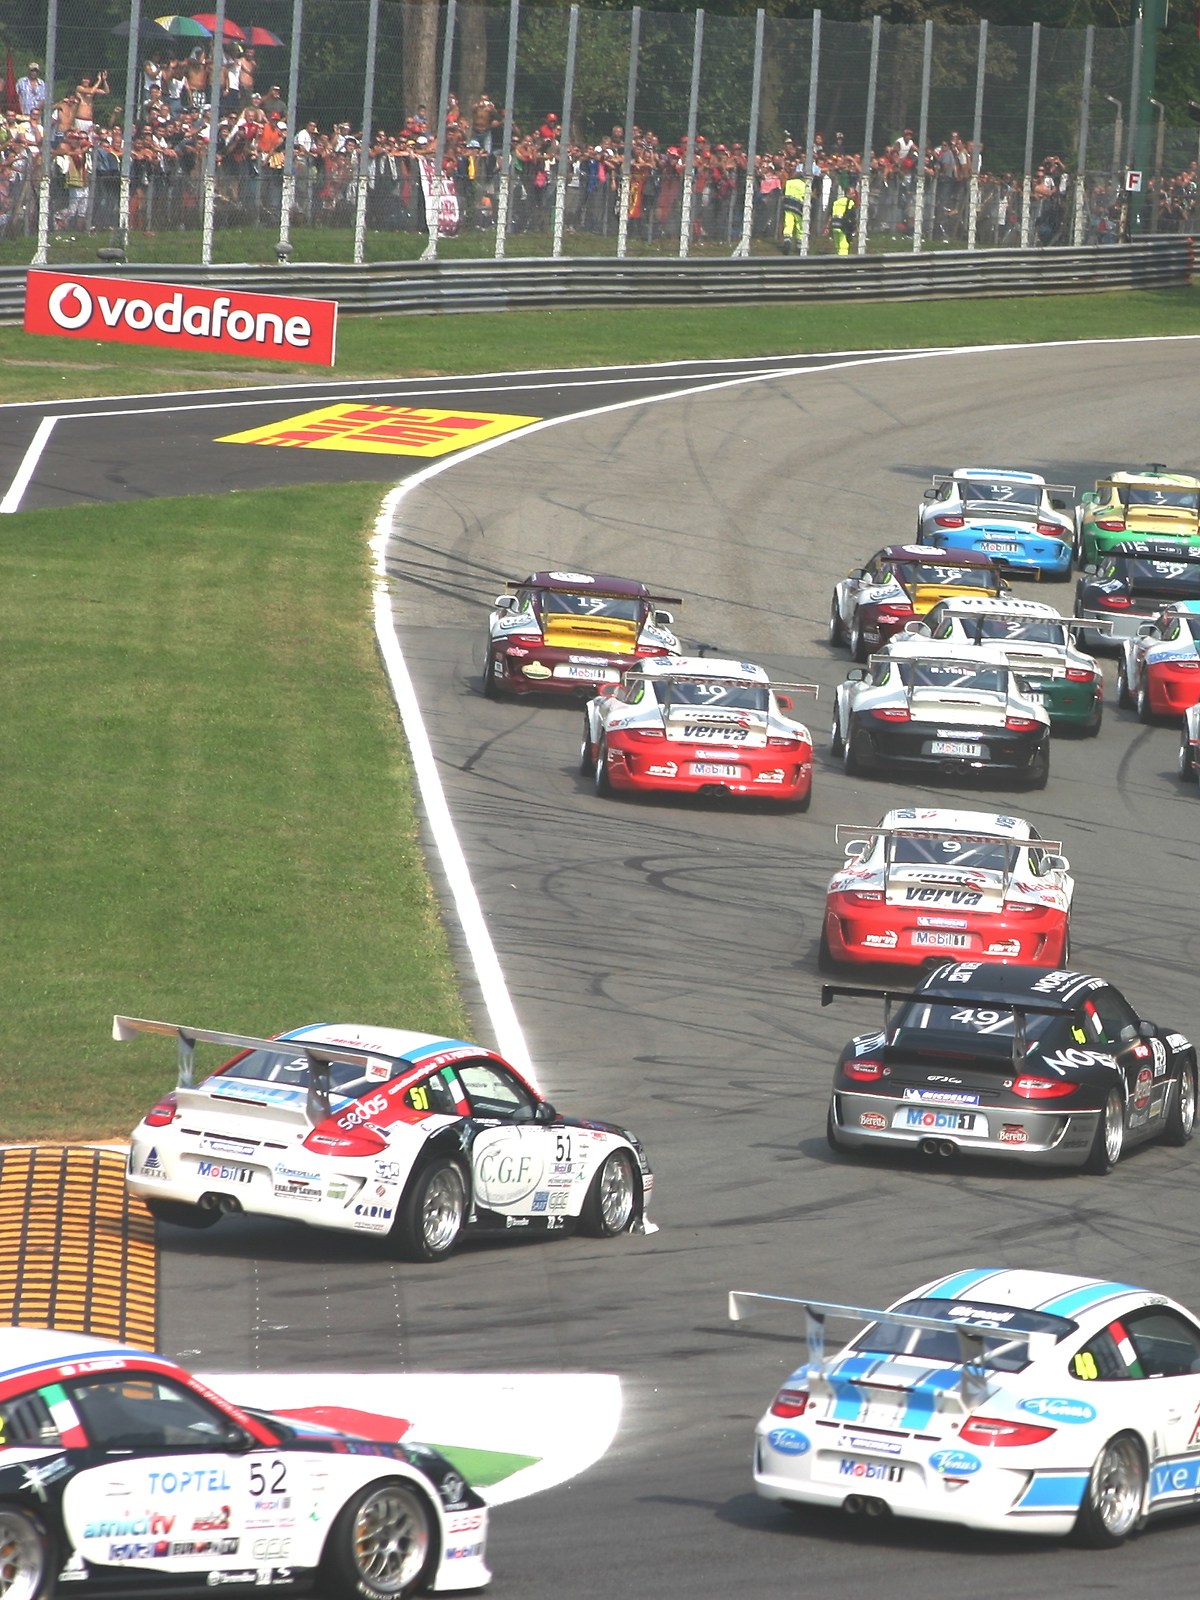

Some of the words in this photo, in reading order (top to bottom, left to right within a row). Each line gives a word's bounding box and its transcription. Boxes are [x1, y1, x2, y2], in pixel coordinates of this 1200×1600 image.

[1128, 172, 1141, 189] F
[97, 292, 312, 348] vodafone
[990, 485, 1012, 493] 12
[580, 597, 605, 607] 15
[697, 684, 727, 695] 10
[684, 726, 750, 741] verva
[694, 764, 724, 775] Mobil
[943, 841, 961, 853] 9
[905, 888, 984, 906] verva
[916, 932, 951, 945] Mobil
[949, 1009, 1000, 1025] 49
[409, 1085, 429, 1110] 51
[921, 1091, 976, 1103] MICHELIN
[337, 1094, 388, 1130] sedos
[907, 1108, 959, 1129] Mobil
[555, 1134, 571, 1162] 51
[197, 1161, 239, 1181] Mobil
[1024, 1398, 1092, 1419] Venus
[772, 1430, 807, 1451] Venus
[839, 1459, 887, 1480] Mobil
[933, 1451, 977, 1470] Venus
[148, 1469, 231, 1495] TOPTEL
[249, 1460, 287, 1496] 52
